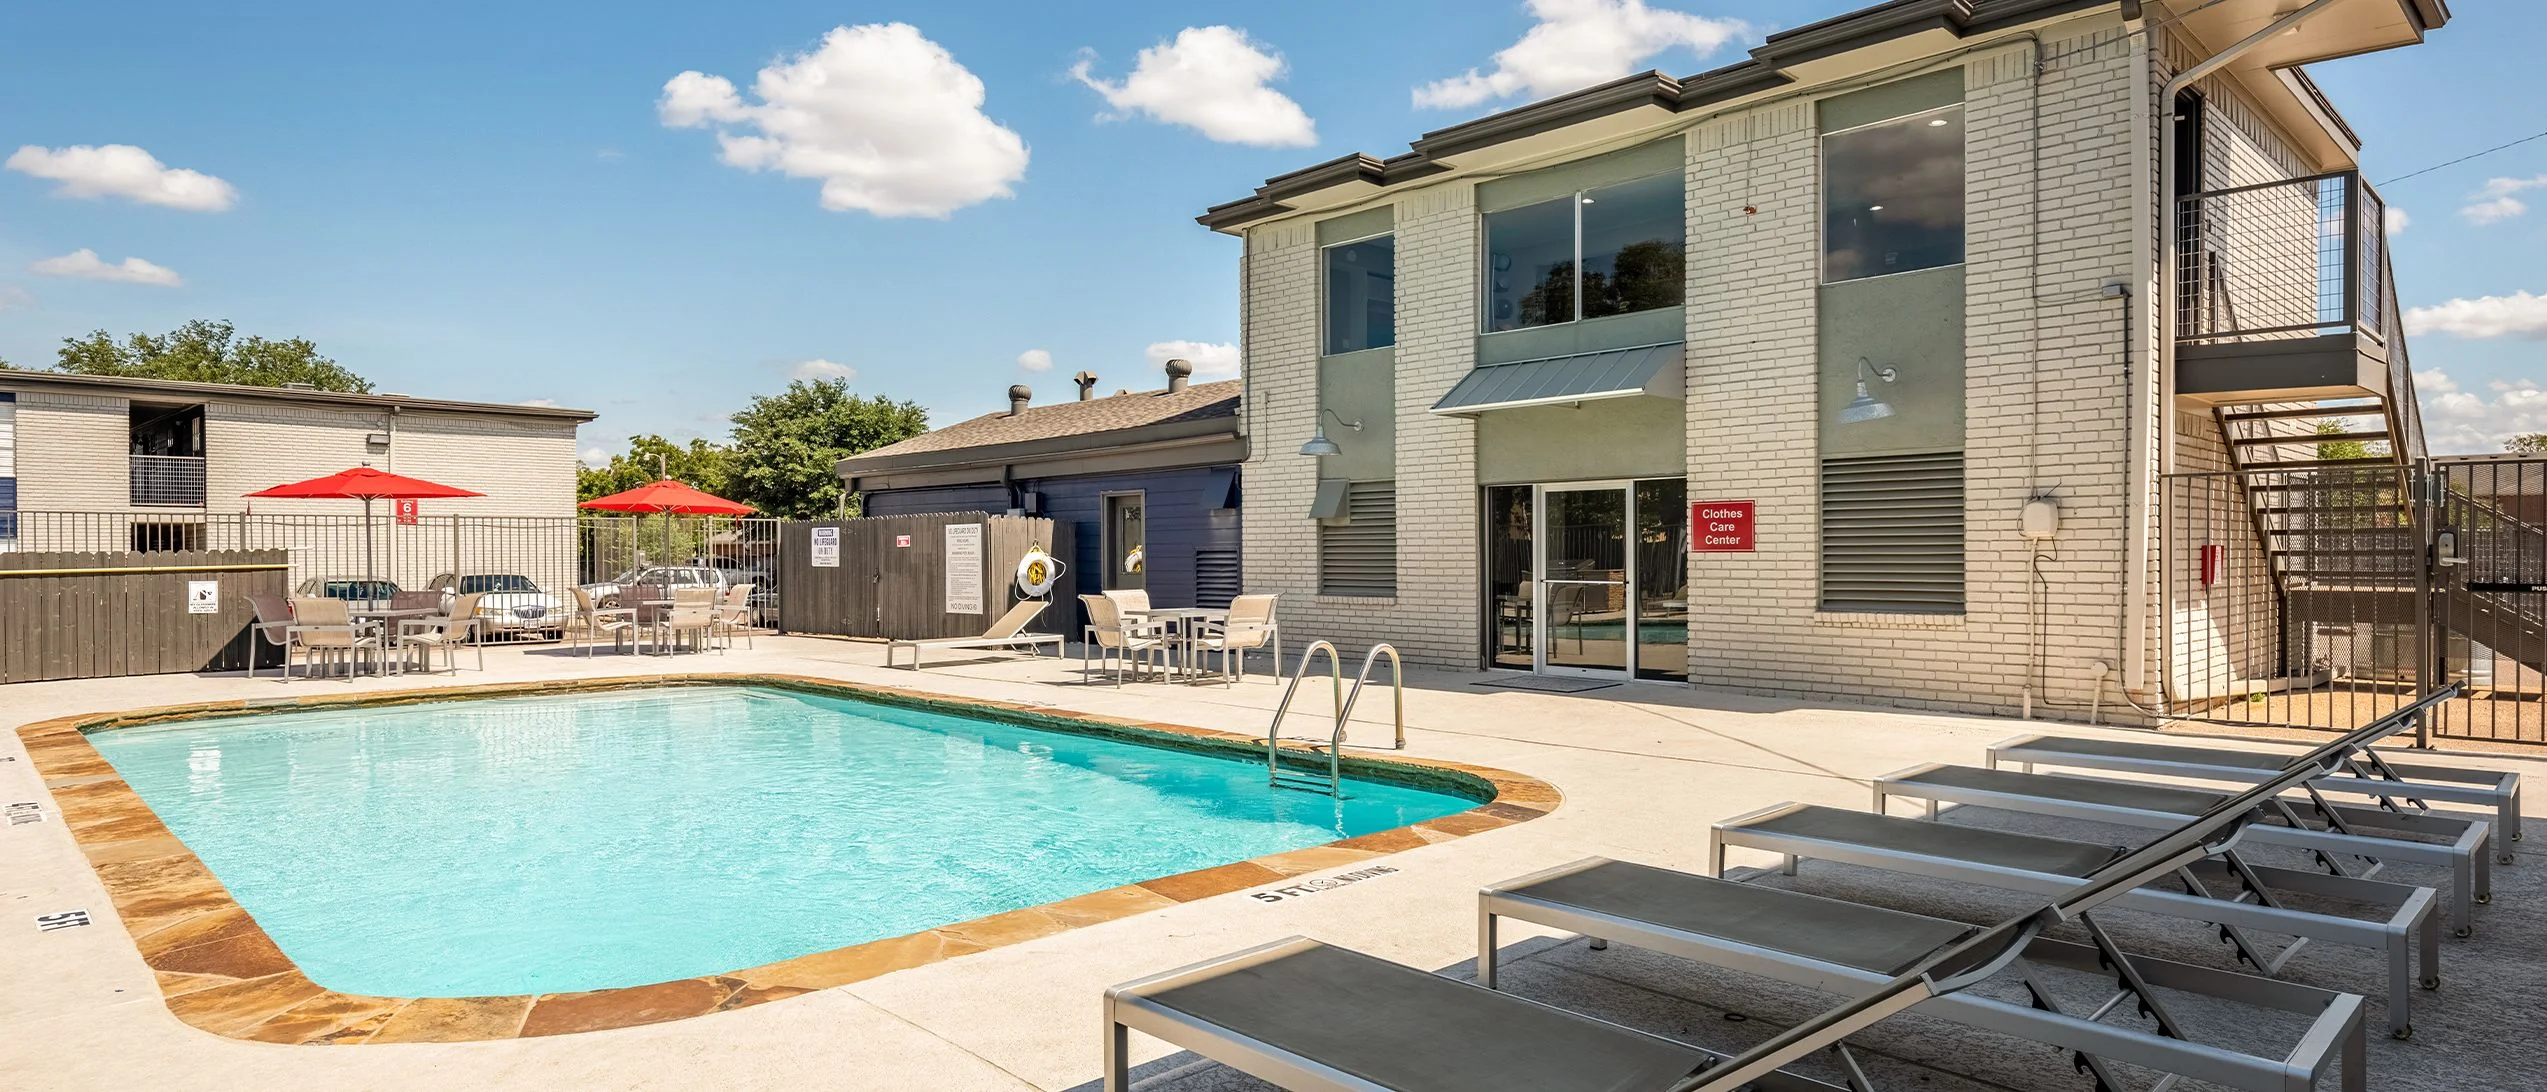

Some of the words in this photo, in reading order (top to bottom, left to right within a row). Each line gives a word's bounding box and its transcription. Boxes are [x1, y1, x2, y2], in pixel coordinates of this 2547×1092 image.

[404, 503, 412, 513] 6
[1702, 509, 1743, 519] Clothes
[1710, 522, 1735, 532] Care
[814, 538, 819, 546] NO
[820, 538, 837, 546] LIFEGUARD
[1705, 535, 1741, 545] Center
[824, 547, 833, 555] DUTY
[1250, 893, 1283, 902] 5
[1274, 885, 1315, 897] FT
